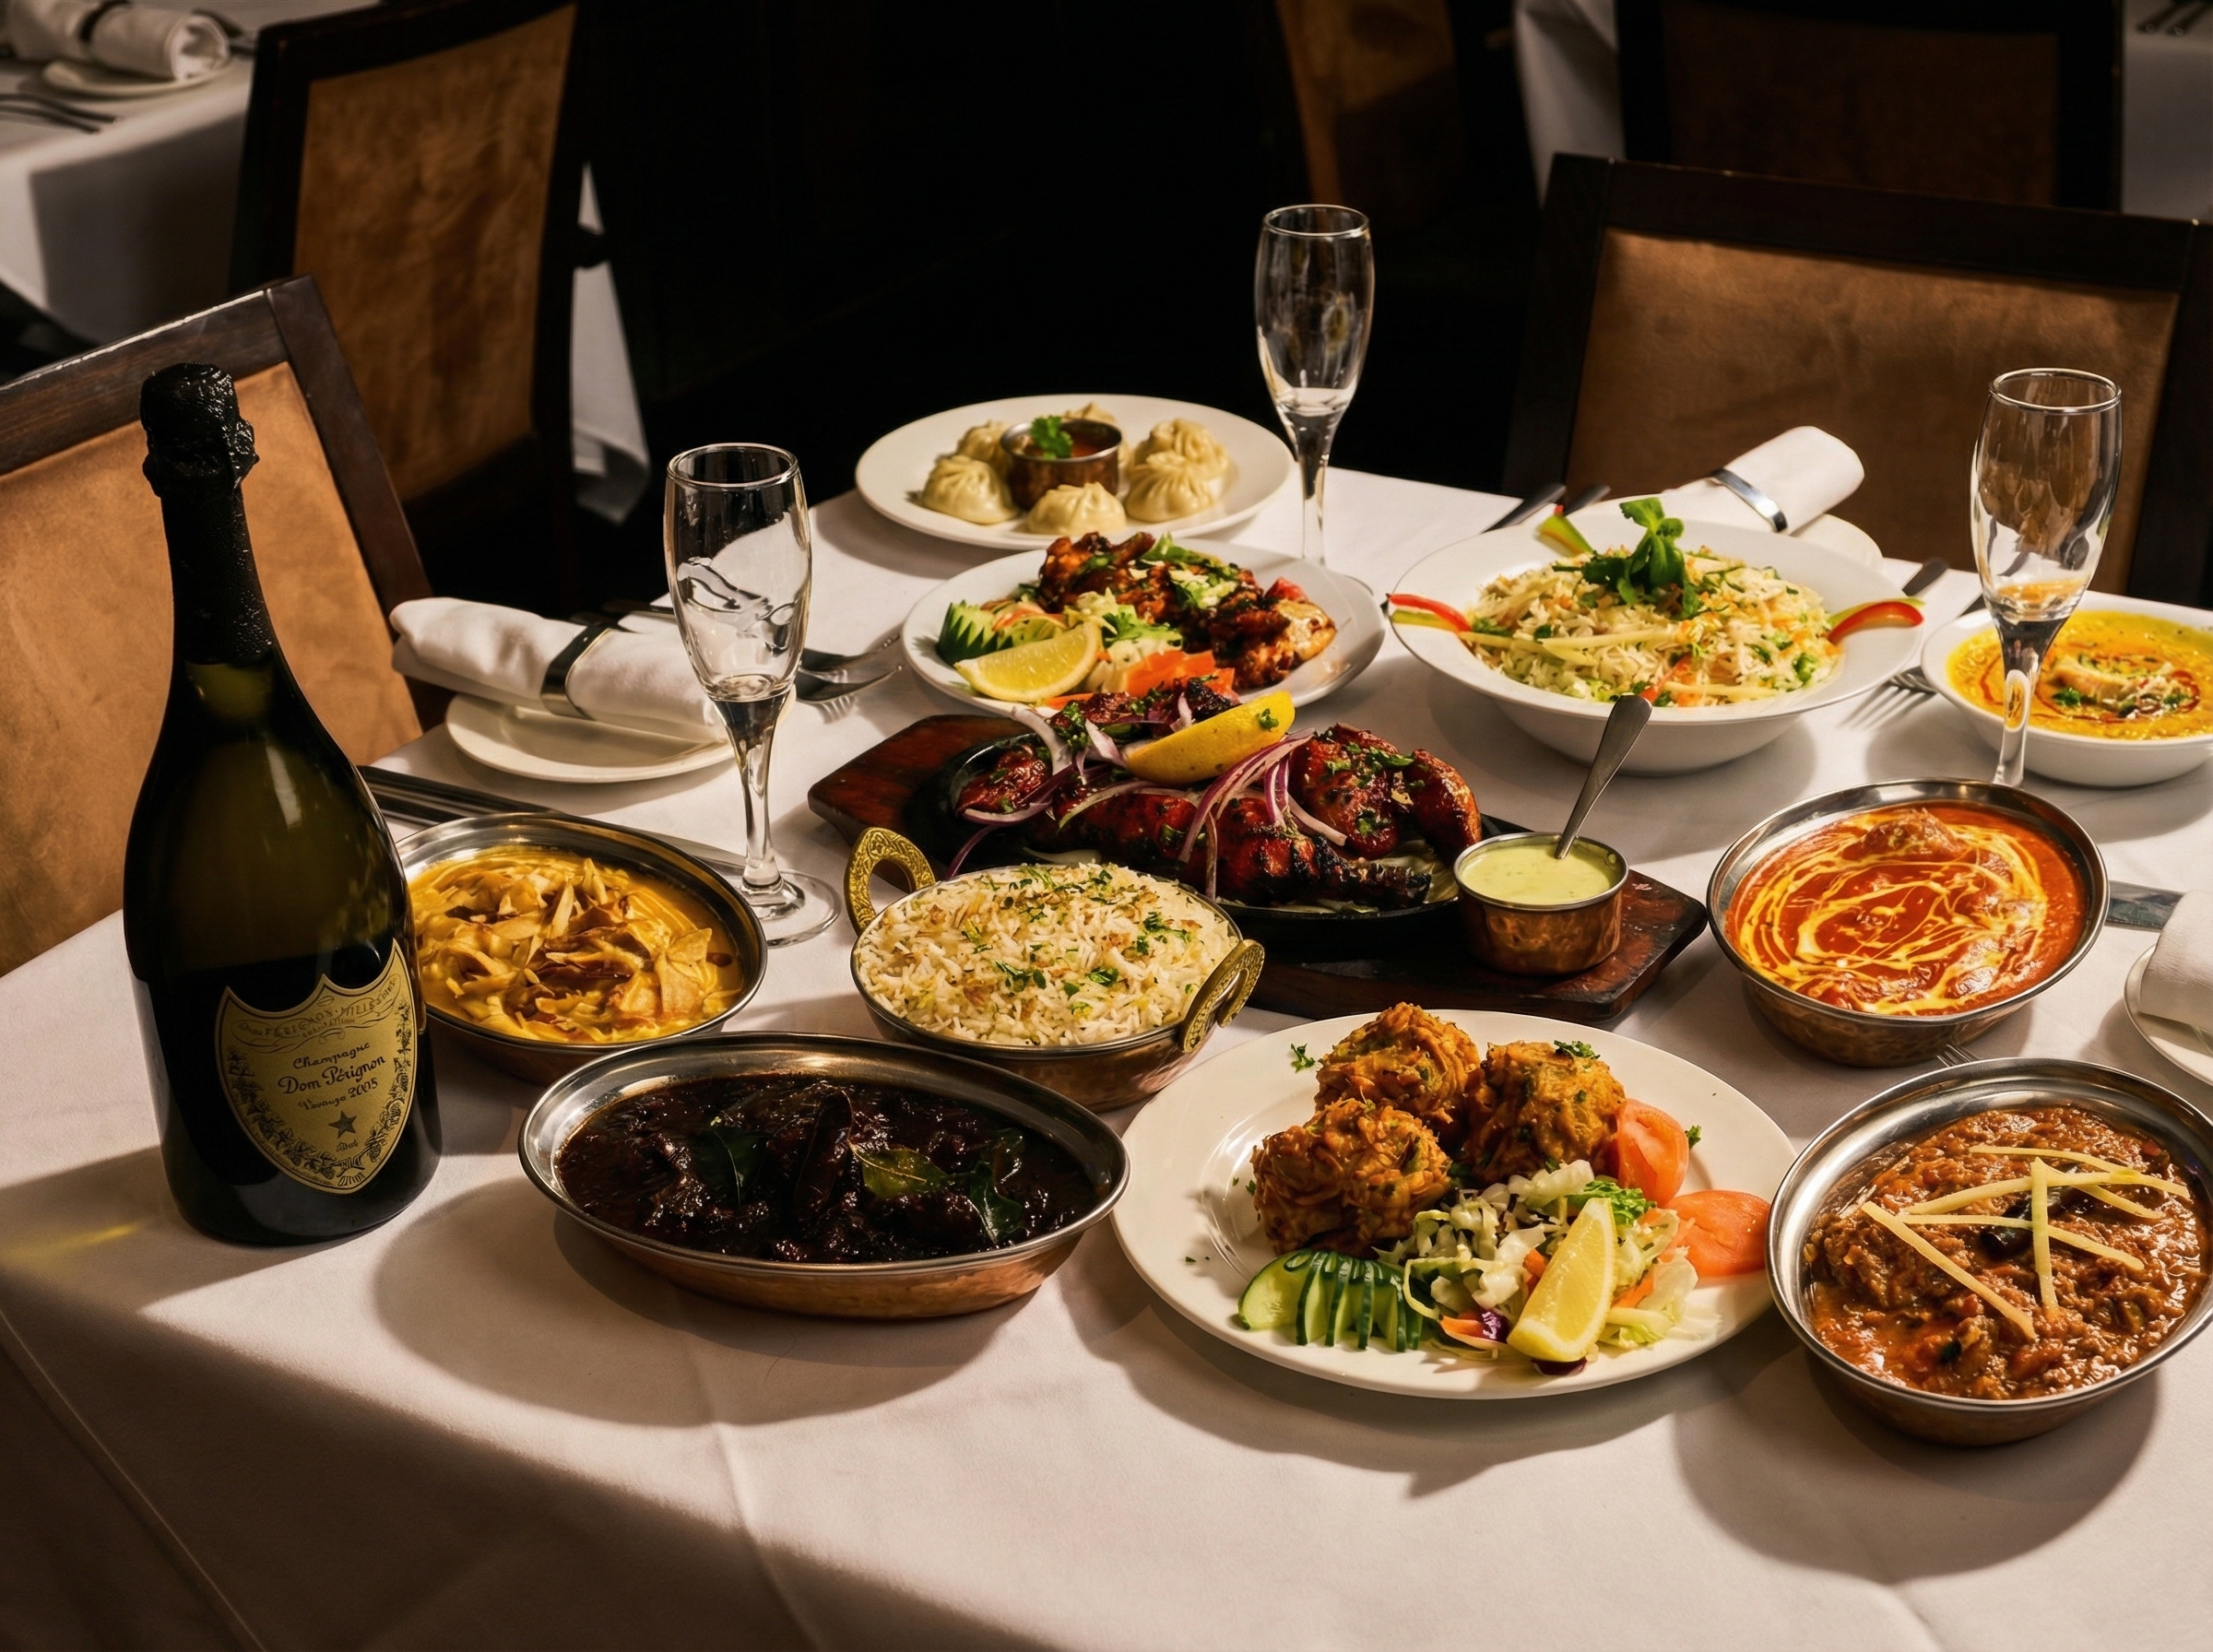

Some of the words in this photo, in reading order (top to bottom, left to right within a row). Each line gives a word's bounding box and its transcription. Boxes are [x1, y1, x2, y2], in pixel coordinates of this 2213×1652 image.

[293, 1043, 371, 1069] Champagne
[278, 1076, 322, 1094] Dom
[322, 1056, 386, 1086] Pérignon
[348, 1077, 378, 1098] 2005
